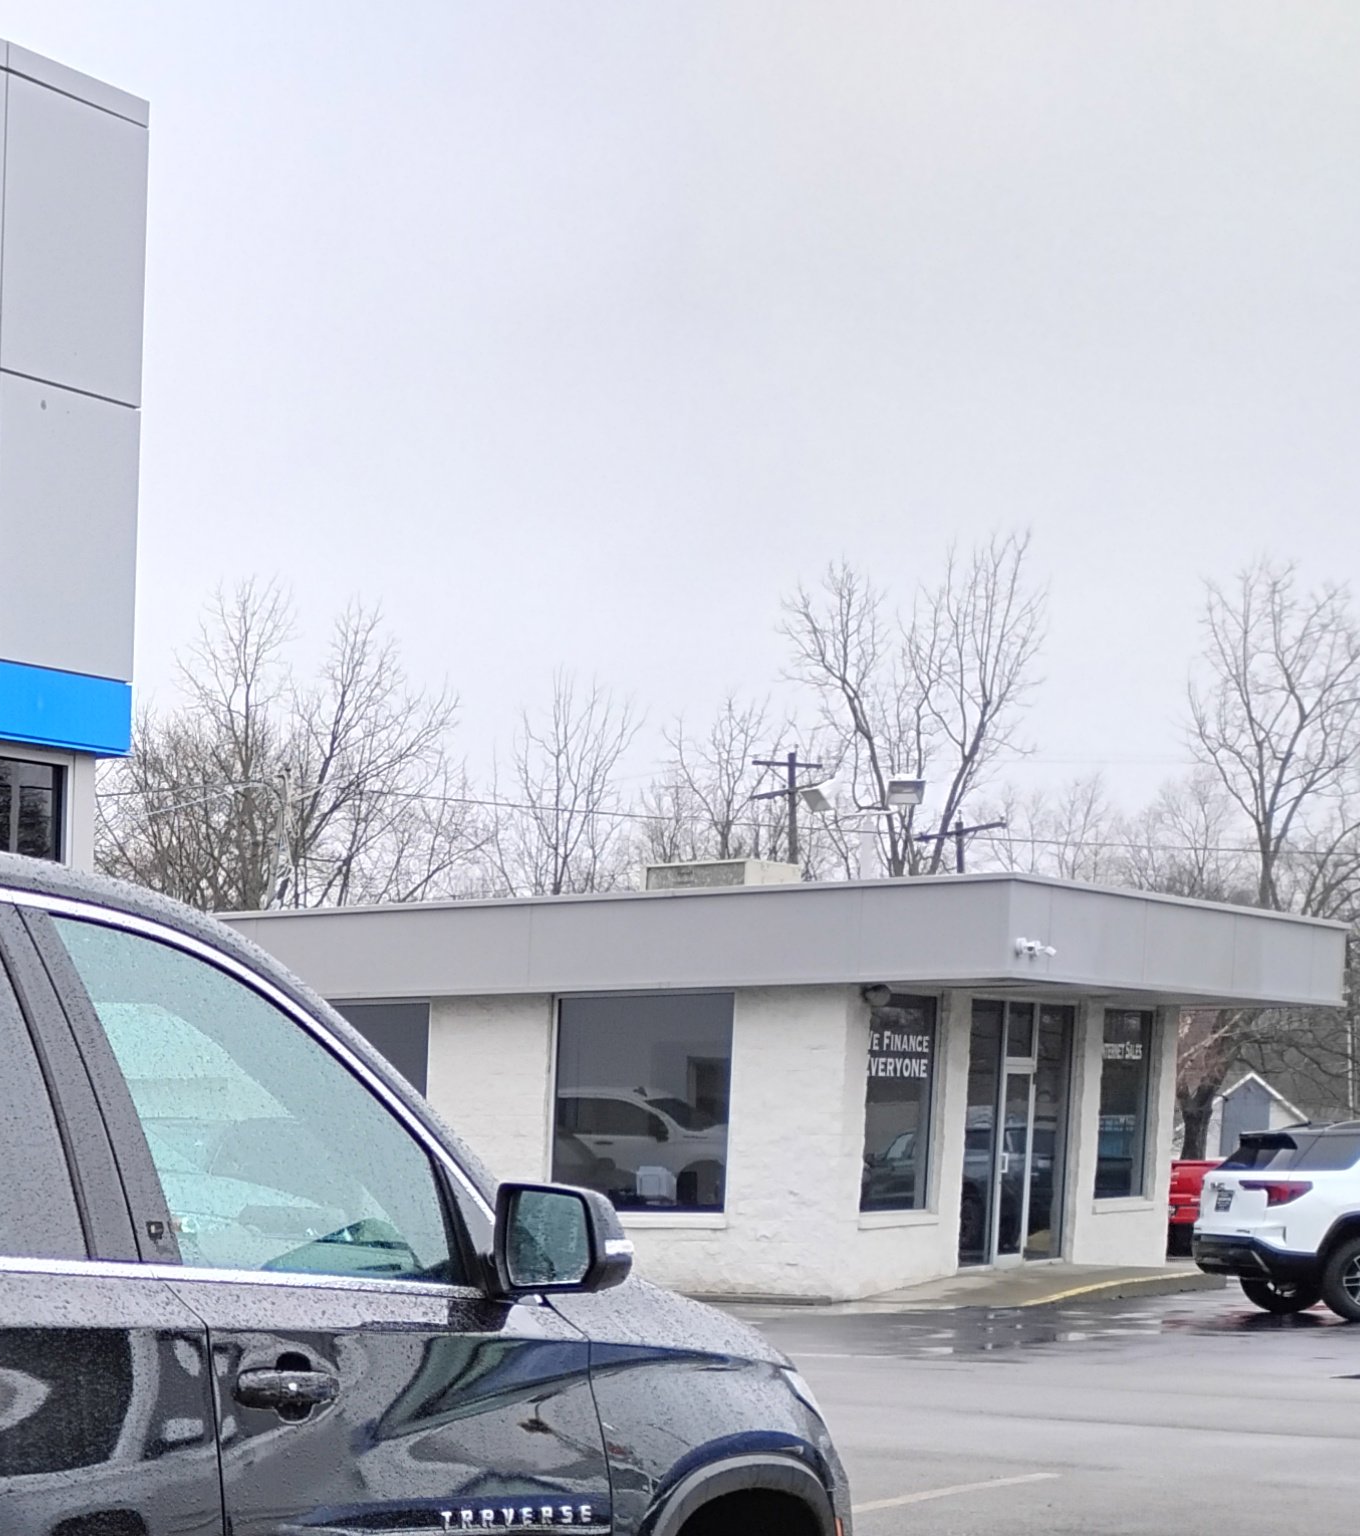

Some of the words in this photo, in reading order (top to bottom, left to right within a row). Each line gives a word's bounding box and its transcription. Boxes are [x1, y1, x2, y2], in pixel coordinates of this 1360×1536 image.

[883, 1030, 929, 1052] FINANCE
[1125, 1041, 1143, 1060] SALES
[441, 1505, 592, 1530] TRAVERSE
